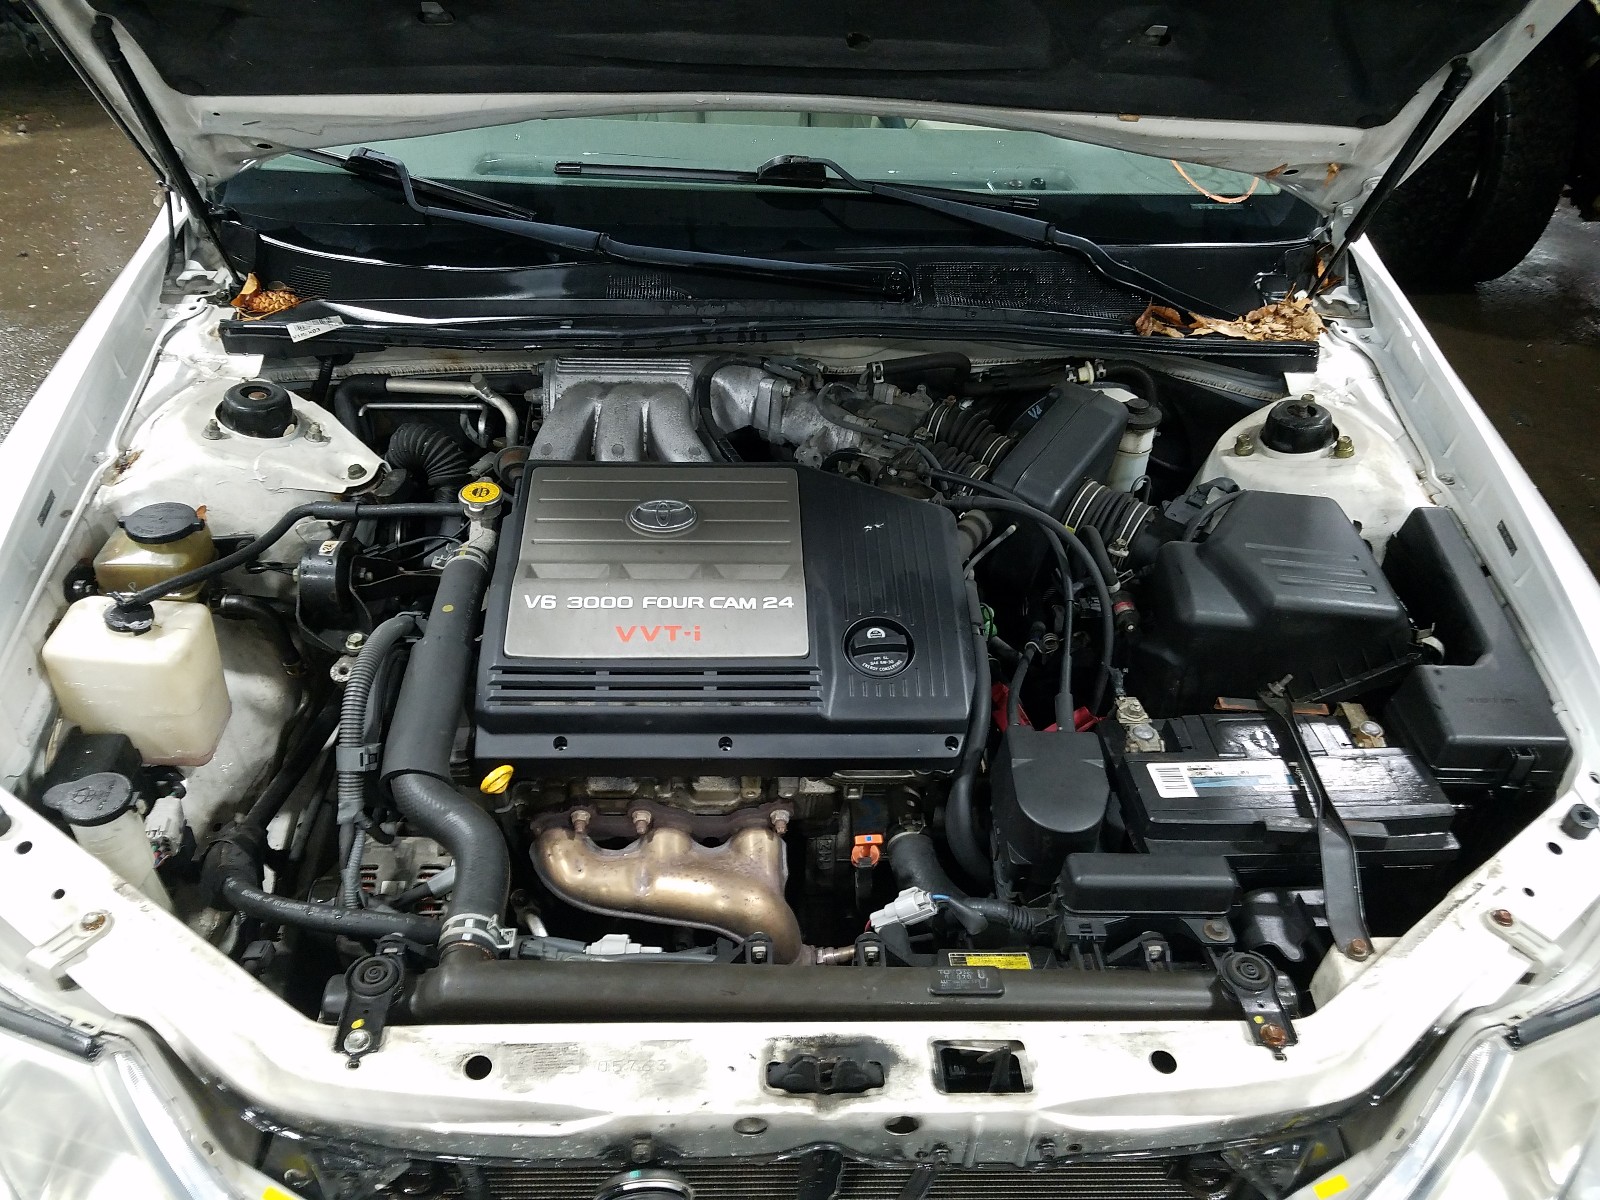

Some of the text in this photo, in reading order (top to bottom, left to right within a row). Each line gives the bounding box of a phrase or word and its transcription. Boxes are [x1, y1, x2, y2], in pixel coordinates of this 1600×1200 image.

[524, 594, 794, 610] V6 3000 FOUR CAM 24
[615, 625, 701, 642] VVT-i
